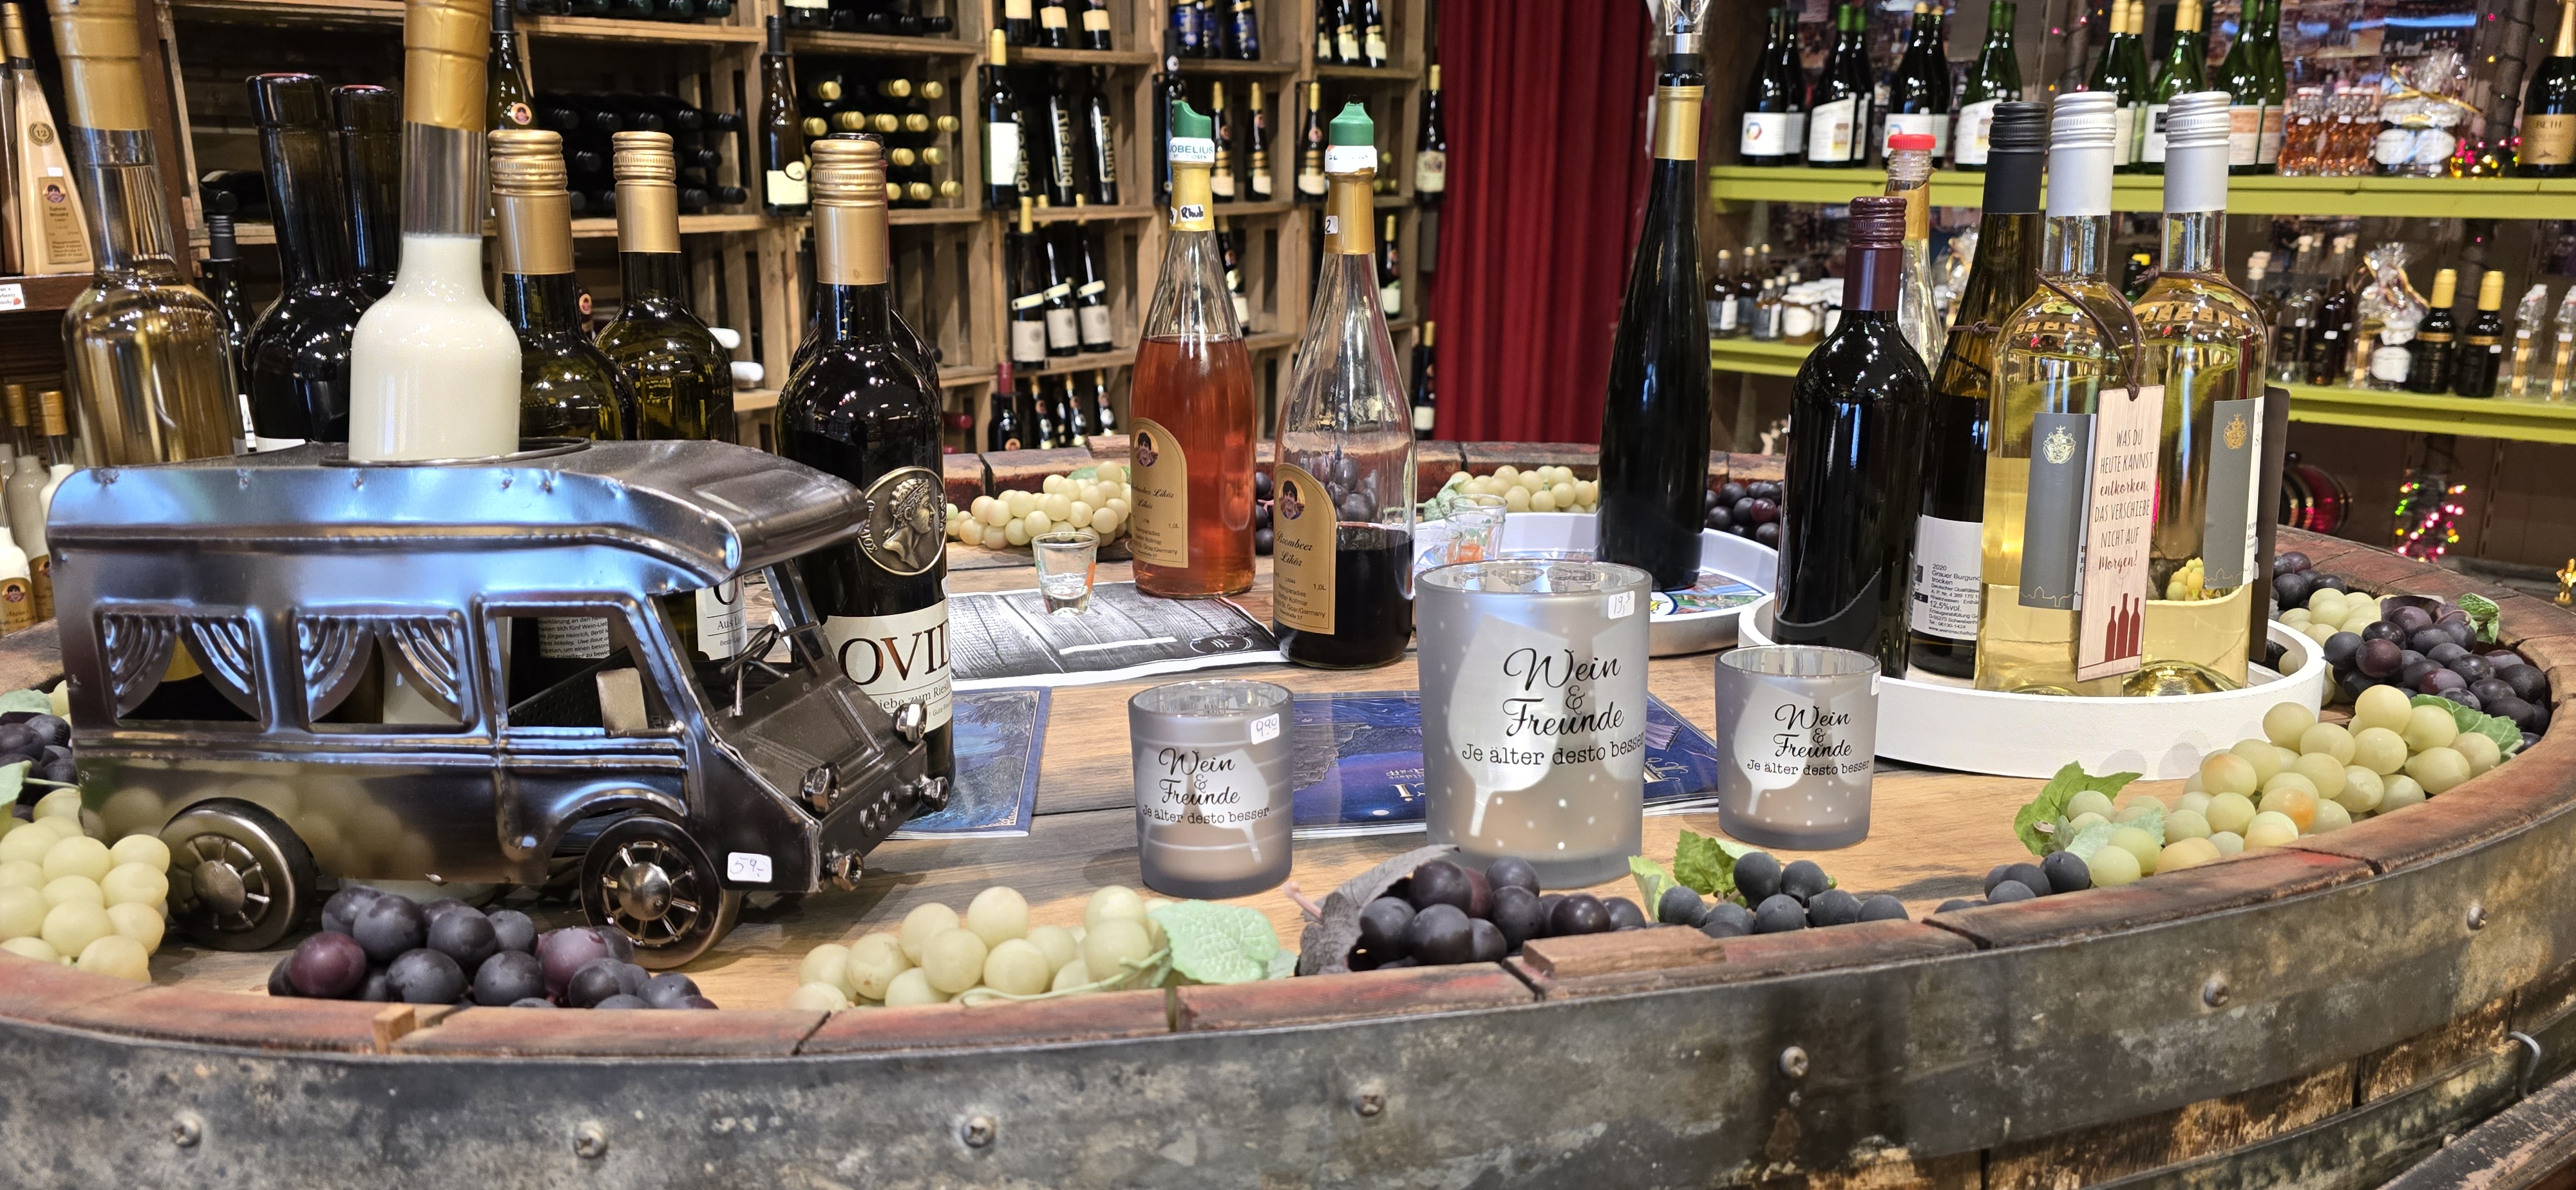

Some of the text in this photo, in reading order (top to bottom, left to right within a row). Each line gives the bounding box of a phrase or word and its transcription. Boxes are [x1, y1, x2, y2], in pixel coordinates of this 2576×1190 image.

[2116, 428, 2144, 448] WAS DU
[2100, 451, 2154, 475] HEUTE KANNST
[2099, 478, 2149, 497] entkorken,
[2094, 499, 2151, 524] DAS VERSCHIEBE
[1276, 531, 1313, 552] Brombeer
[2100, 526, 2140, 549] NICHT AUF
[1280, 550, 1303, 567] Likör
[1932, 563, 1947, 572] 2020
[2098, 549, 2138, 574] Morgen!
[1931, 577, 1953, 585] trocken
[1932, 569, 1953, 579] Grauer
[1287, 603, 1326, 618] Goar/Germany
[1289, 596, 1307, 606] Kollmar
[717, 619, 734, 630] Aus
[1503, 648, 1622, 692] Wein
[877, 697, 905, 710] iebe
[1565, 685, 1586, 715] &
[1502, 697, 1625, 737] Freunde
[1774, 703, 1852, 730] Wein
[1773, 733, 1853, 758] Freunde
[1812, 728, 1826, 746] &
[1159, 747, 1236, 776] Wein
[1462, 743, 1483, 761] Je
[1489, 746, 1544, 765] älter
[1552, 745, 1606, 765] desto
[1747, 759, 1761, 771] Je
[1764, 762, 1799, 775] älter
[1803, 764, 1838, 776] desto
[1159, 779, 1241, 806] Freunde
[1194, 773, 1208, 793] &
[1143, 804, 1152, 817] Je
[1154, 808, 1183, 822] älter
[1187, 813, 1225, 824] desto
